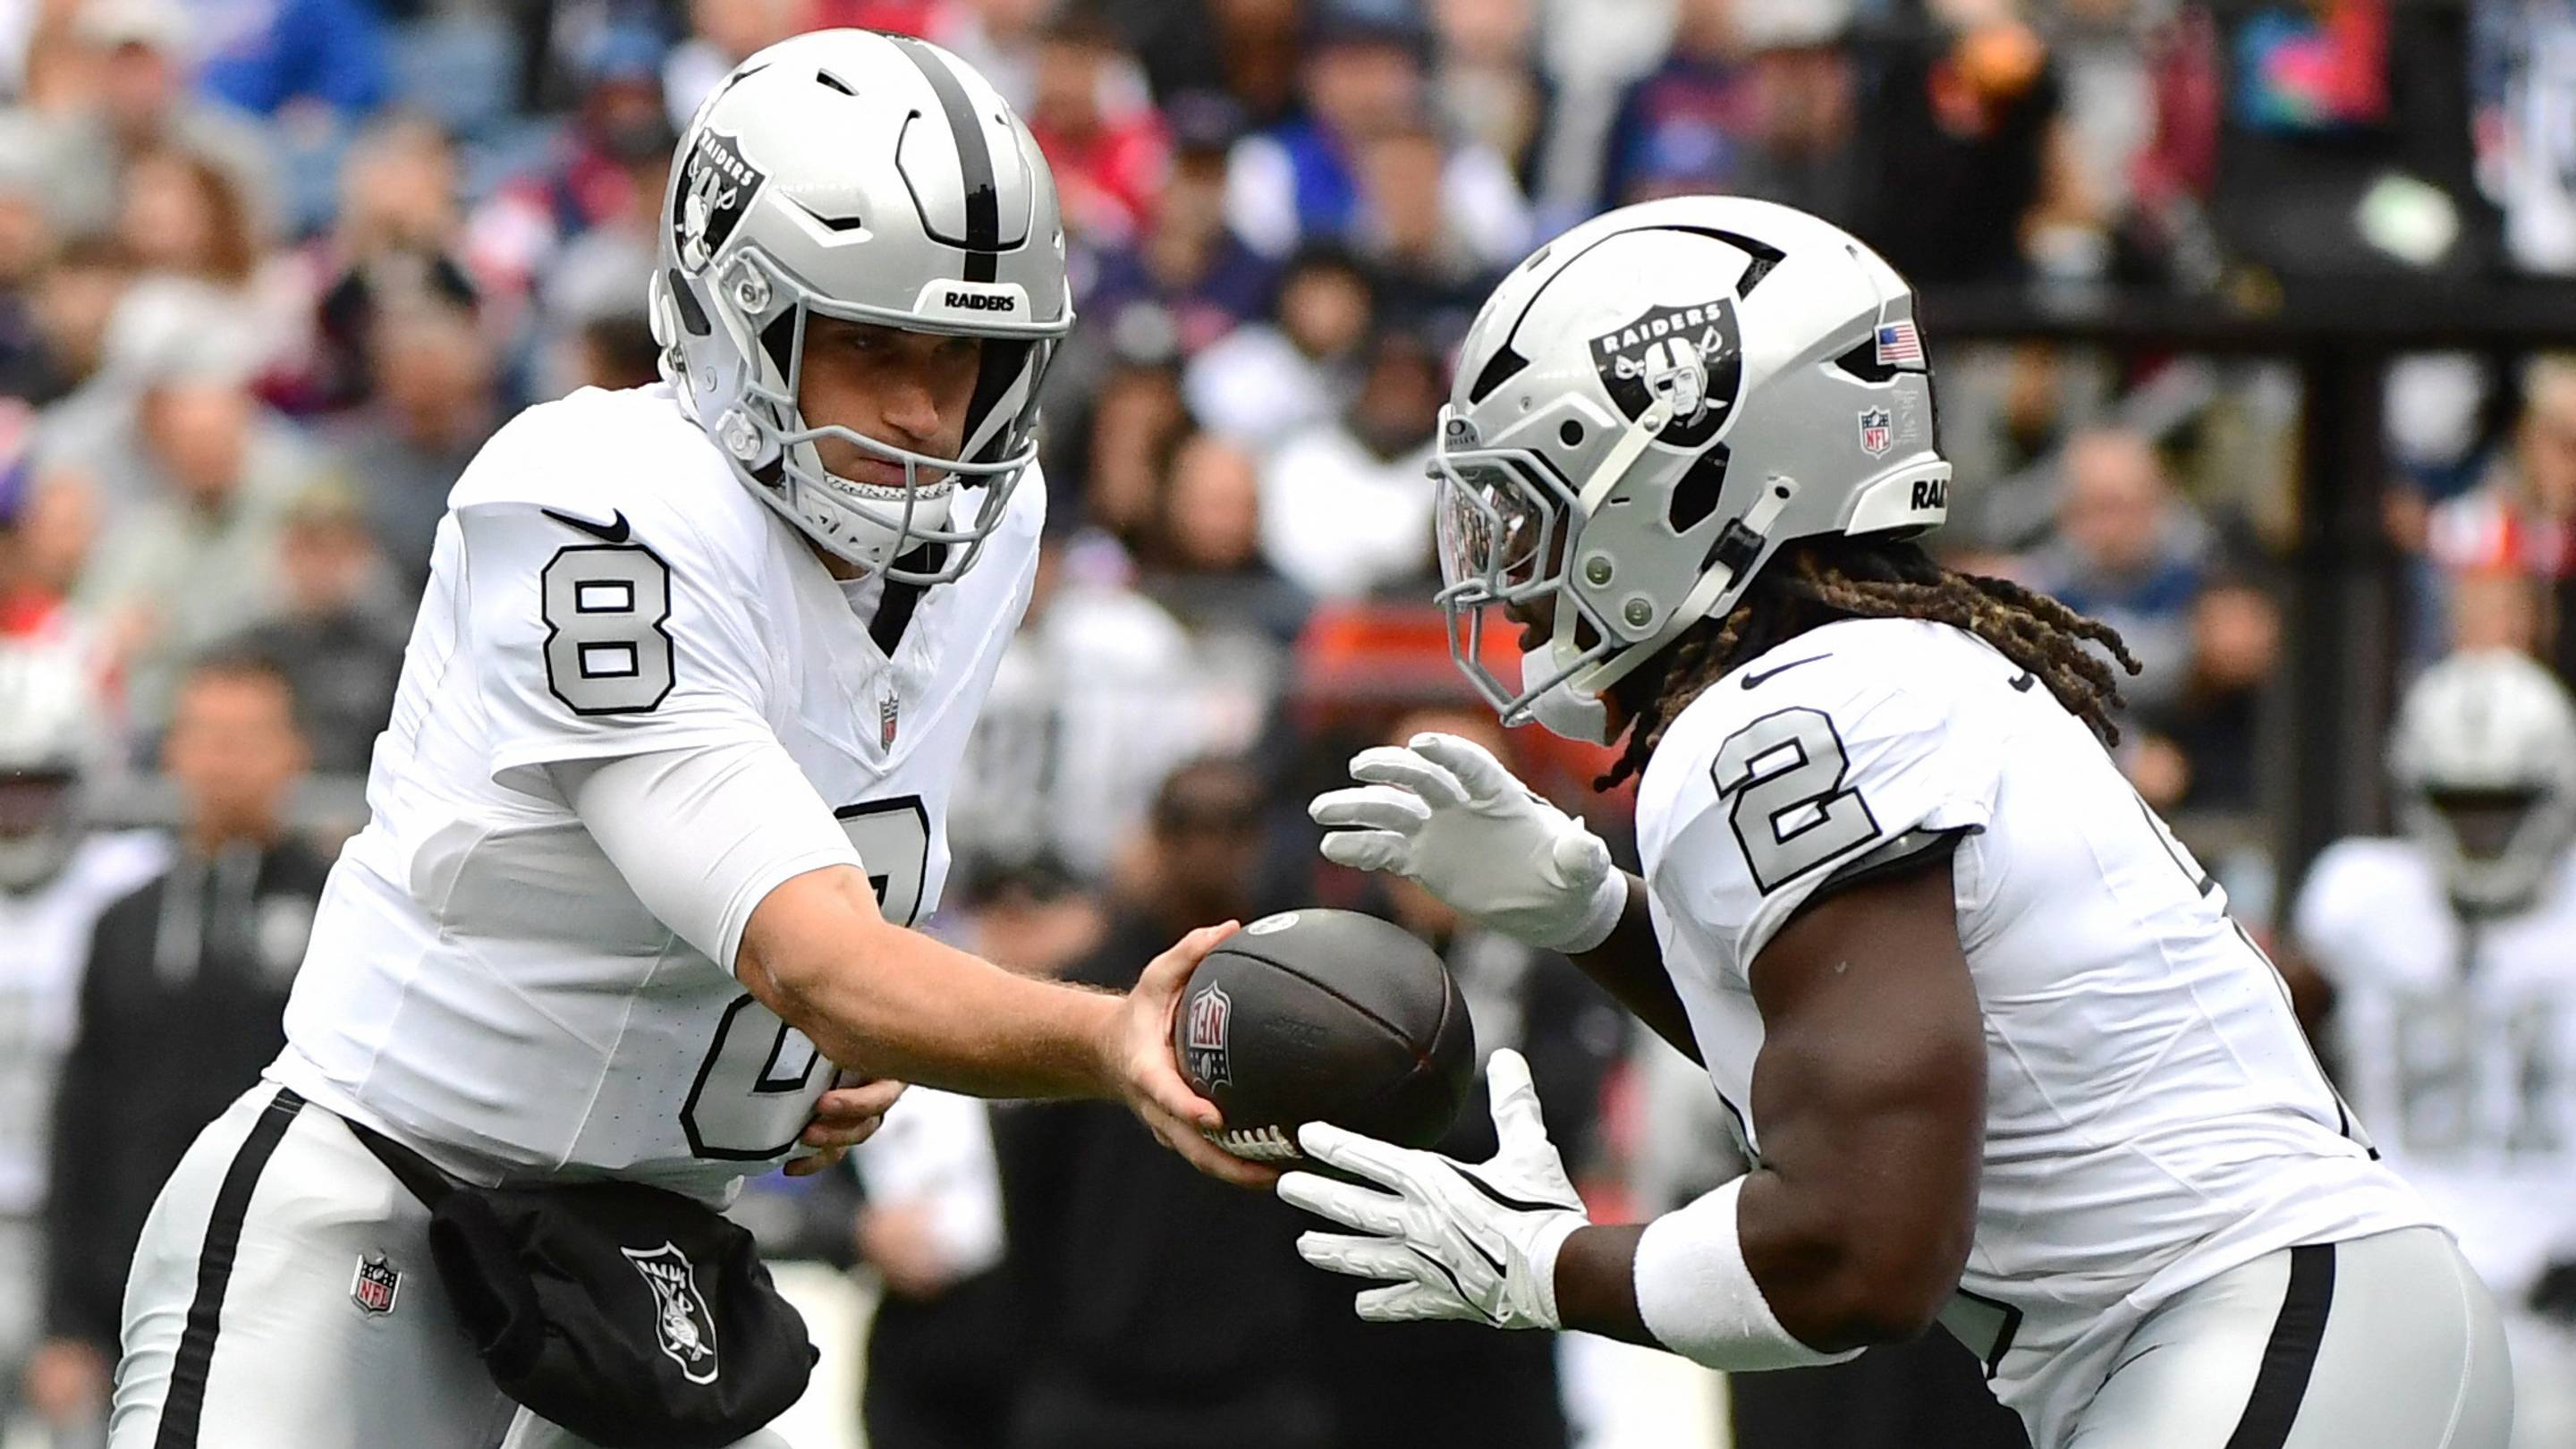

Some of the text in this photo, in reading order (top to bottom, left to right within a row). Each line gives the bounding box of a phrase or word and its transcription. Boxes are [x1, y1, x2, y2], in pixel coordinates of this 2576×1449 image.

[699, 128, 755, 187] RAIDERS
[945, 291, 1015, 312] RAIDERS
[1602, 303, 1722, 354] RAIDERS
[1866, 428, 1890, 450] NFL
[540, 543, 676, 716] 8
[1709, 706, 1883, 897] 2
[1192, 995, 1224, 1046] NFL
[359, 1279, 388, 1309] NFL
